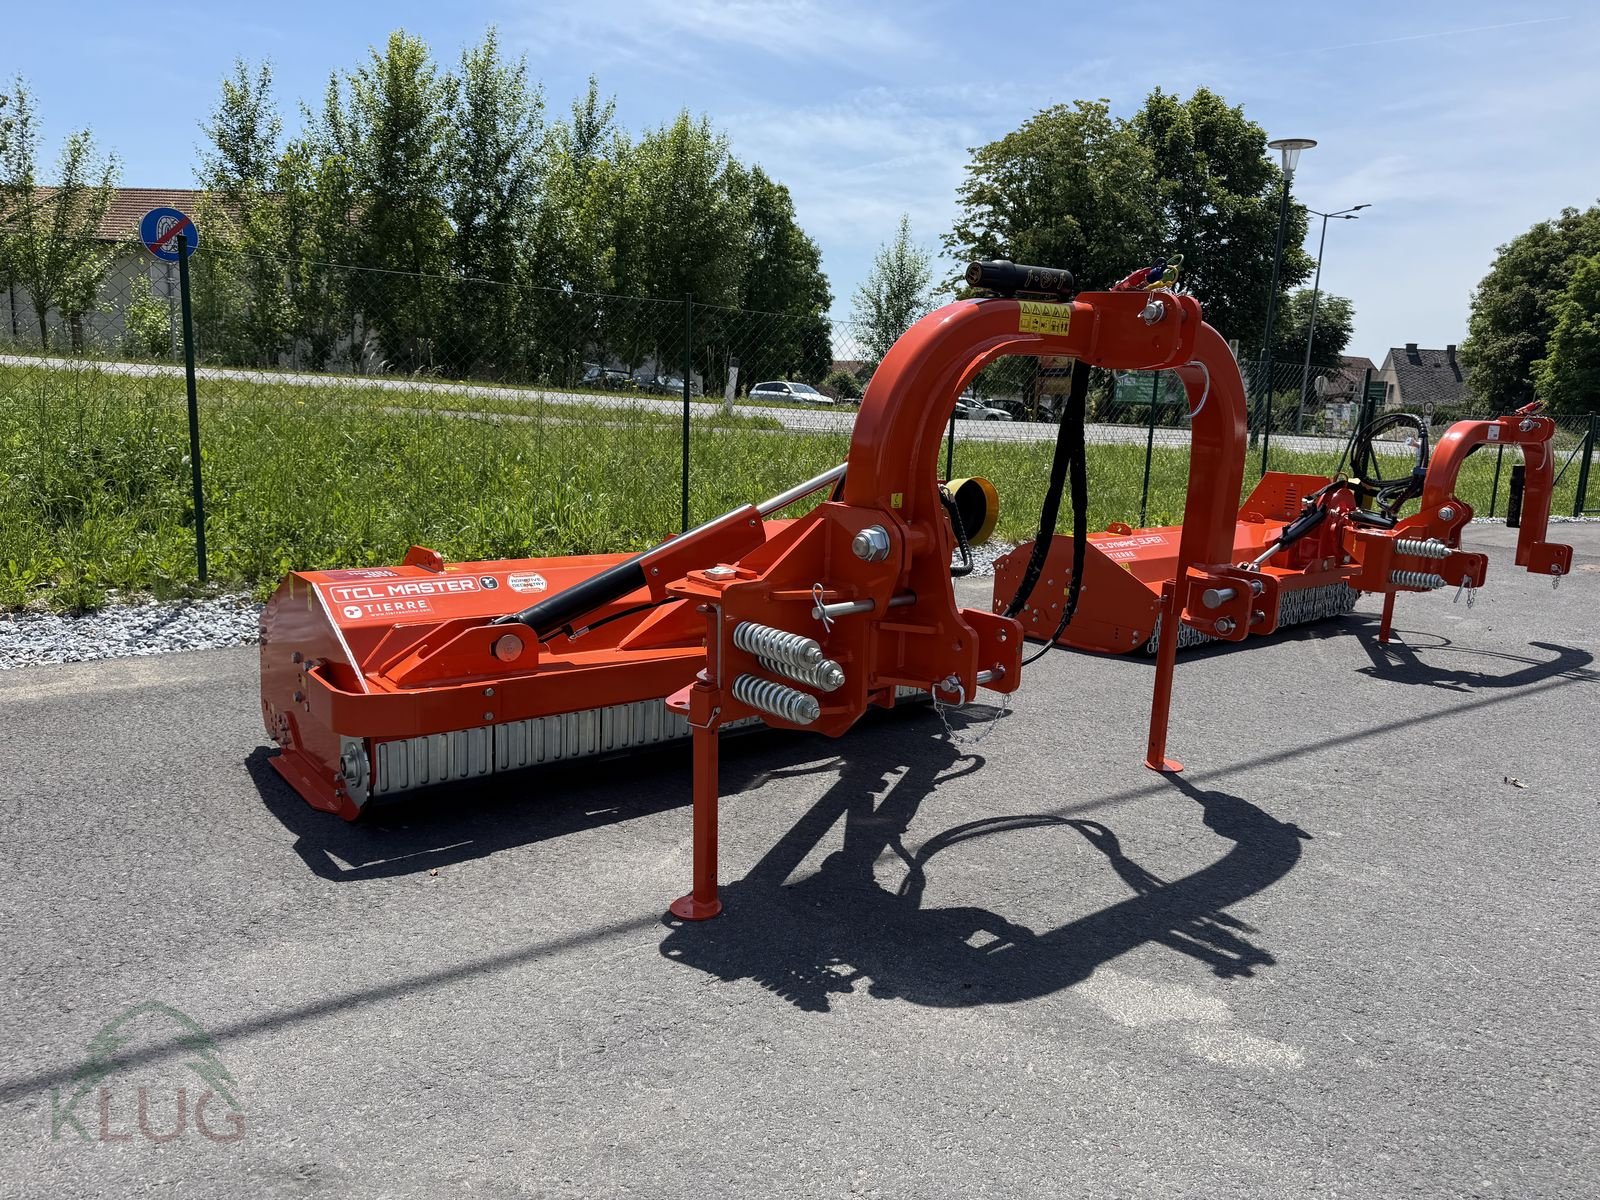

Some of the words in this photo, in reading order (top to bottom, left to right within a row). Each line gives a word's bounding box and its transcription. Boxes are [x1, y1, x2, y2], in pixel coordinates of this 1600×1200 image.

[1107, 540, 1137, 548] DYNAMIC
[1138, 536, 1163, 545] SUPER
[336, 587, 385, 600] TCL
[387, 579, 476, 596] MASTER
[363, 600, 428, 613] TIERRE
